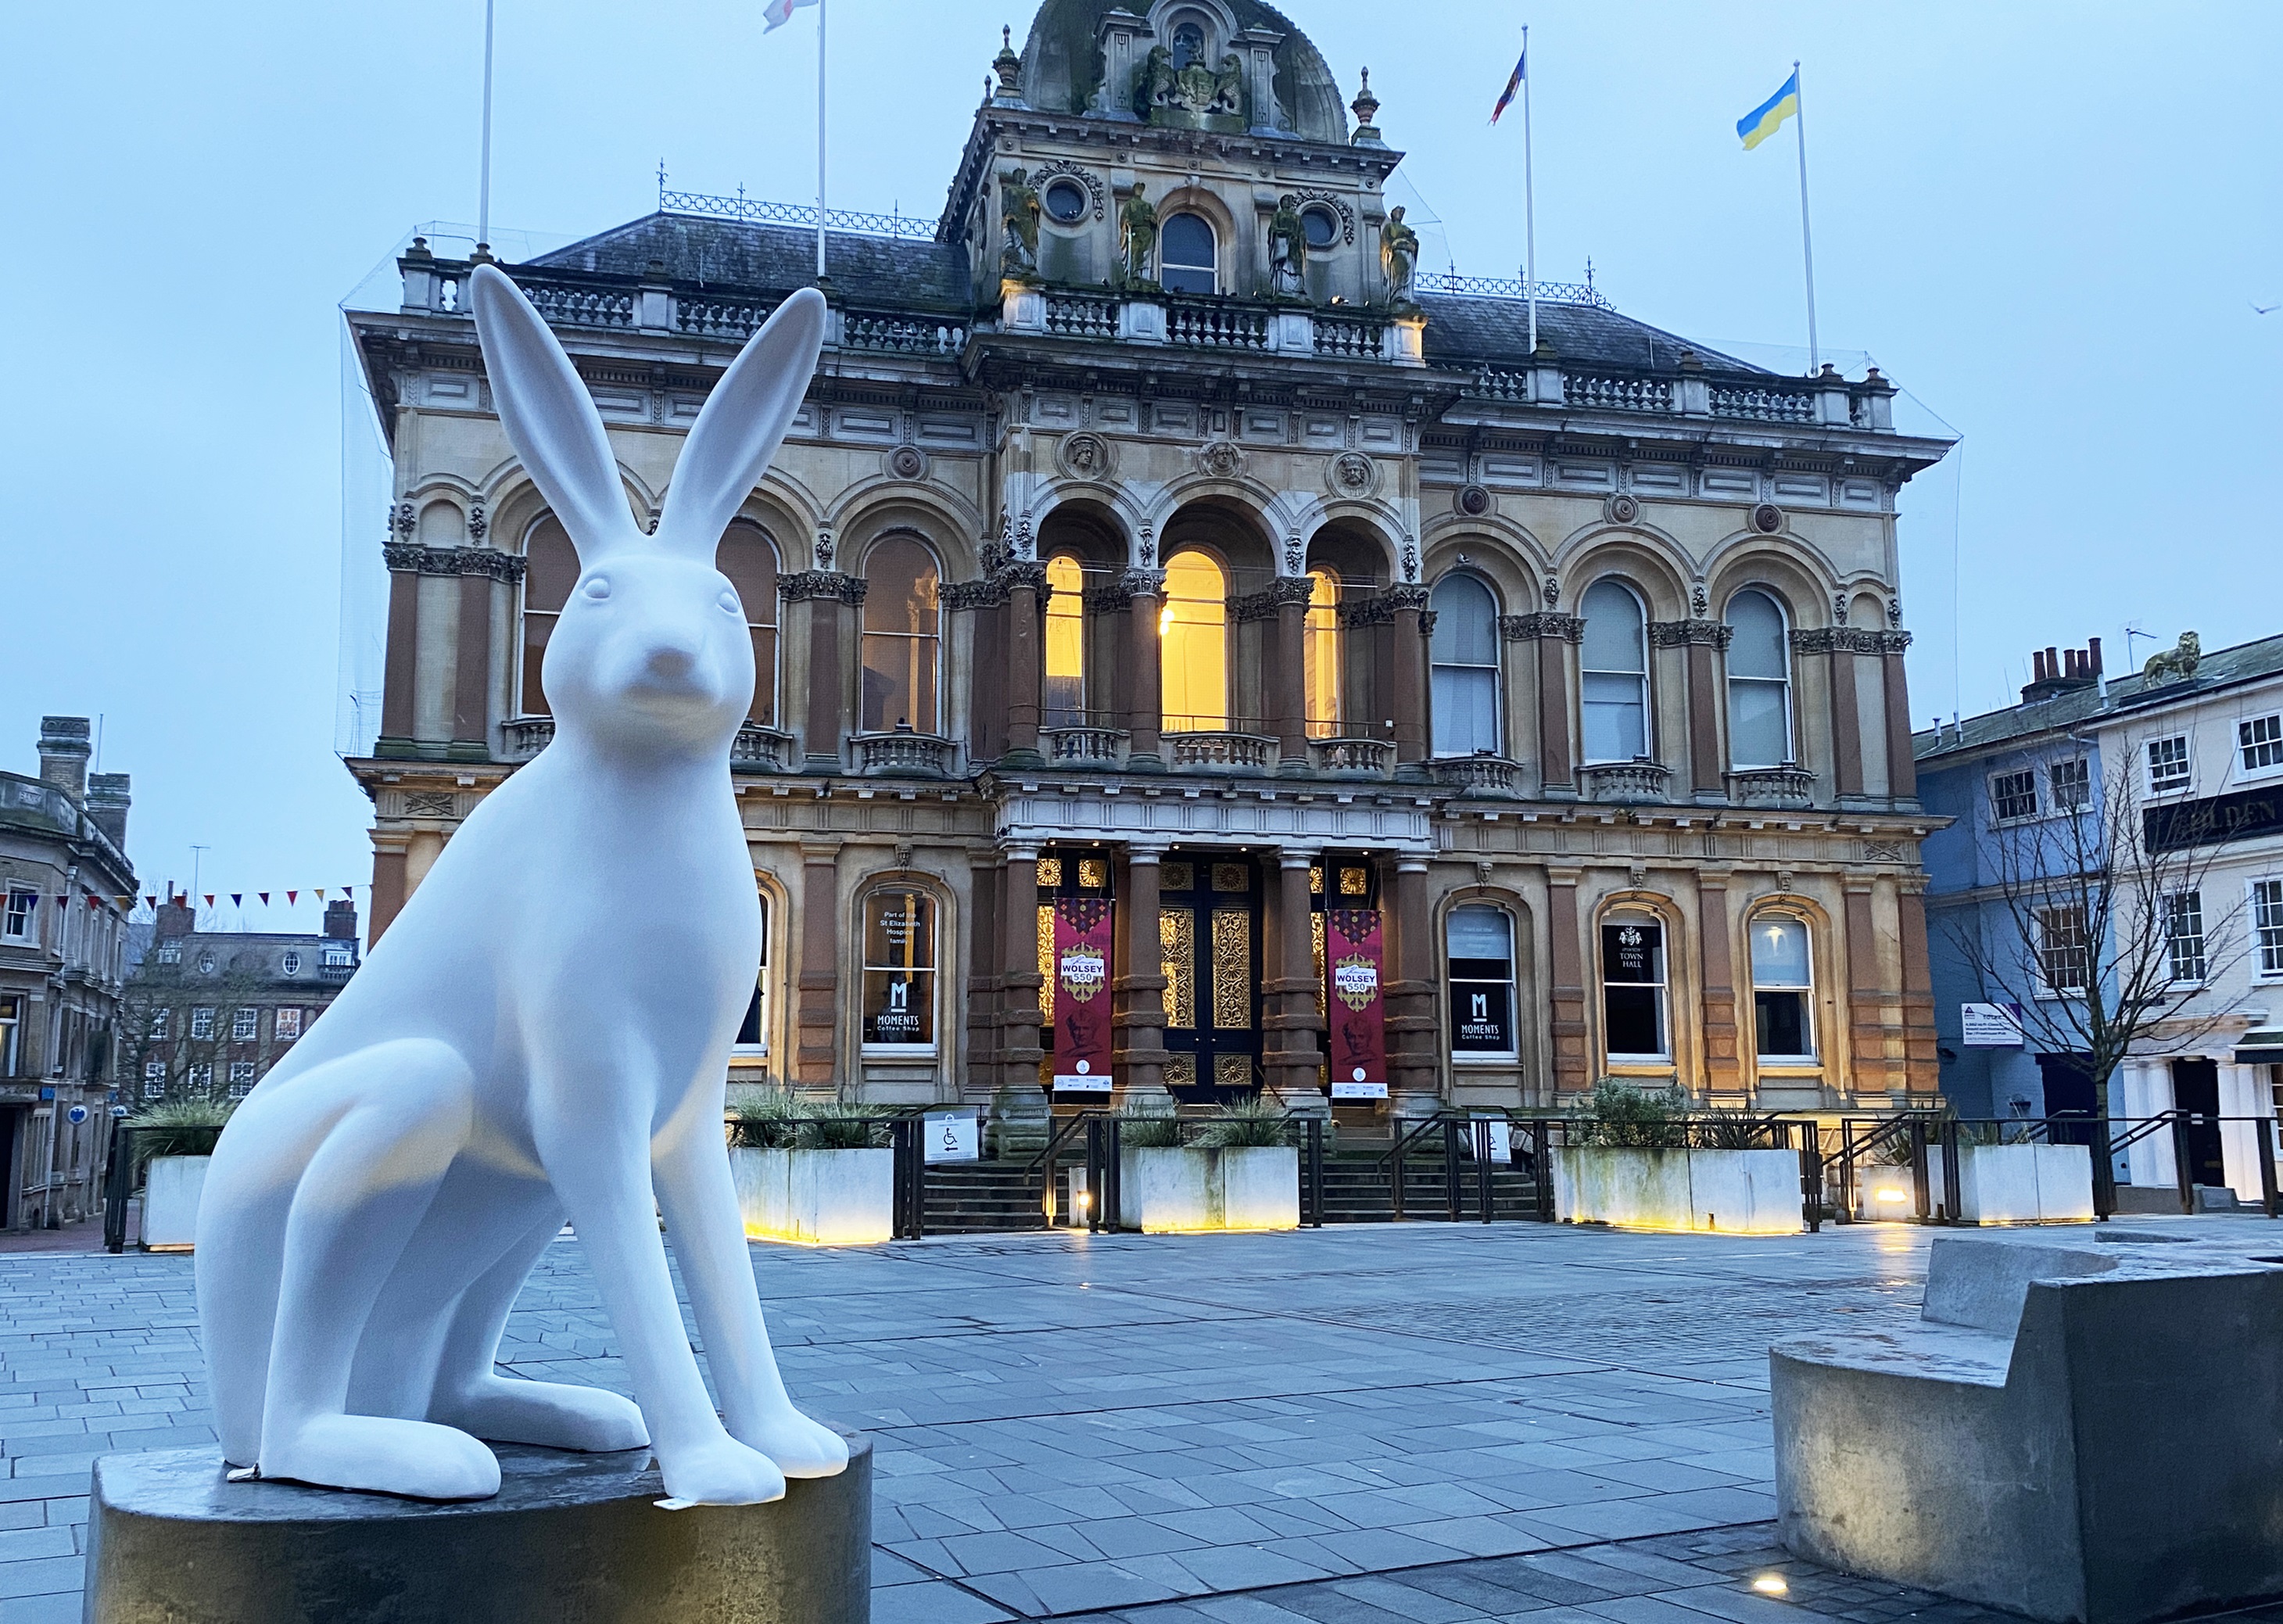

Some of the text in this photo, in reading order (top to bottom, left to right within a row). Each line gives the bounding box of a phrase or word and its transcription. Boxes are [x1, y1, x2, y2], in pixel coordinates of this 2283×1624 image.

[1073, 973, 1092, 981] 550
[891, 982, 907, 1007] M
[1471, 993, 1487, 1017] M
[877, 1015, 919, 1026] MOMENTS
[1461, 1024, 1500, 1034] MOMENTS
